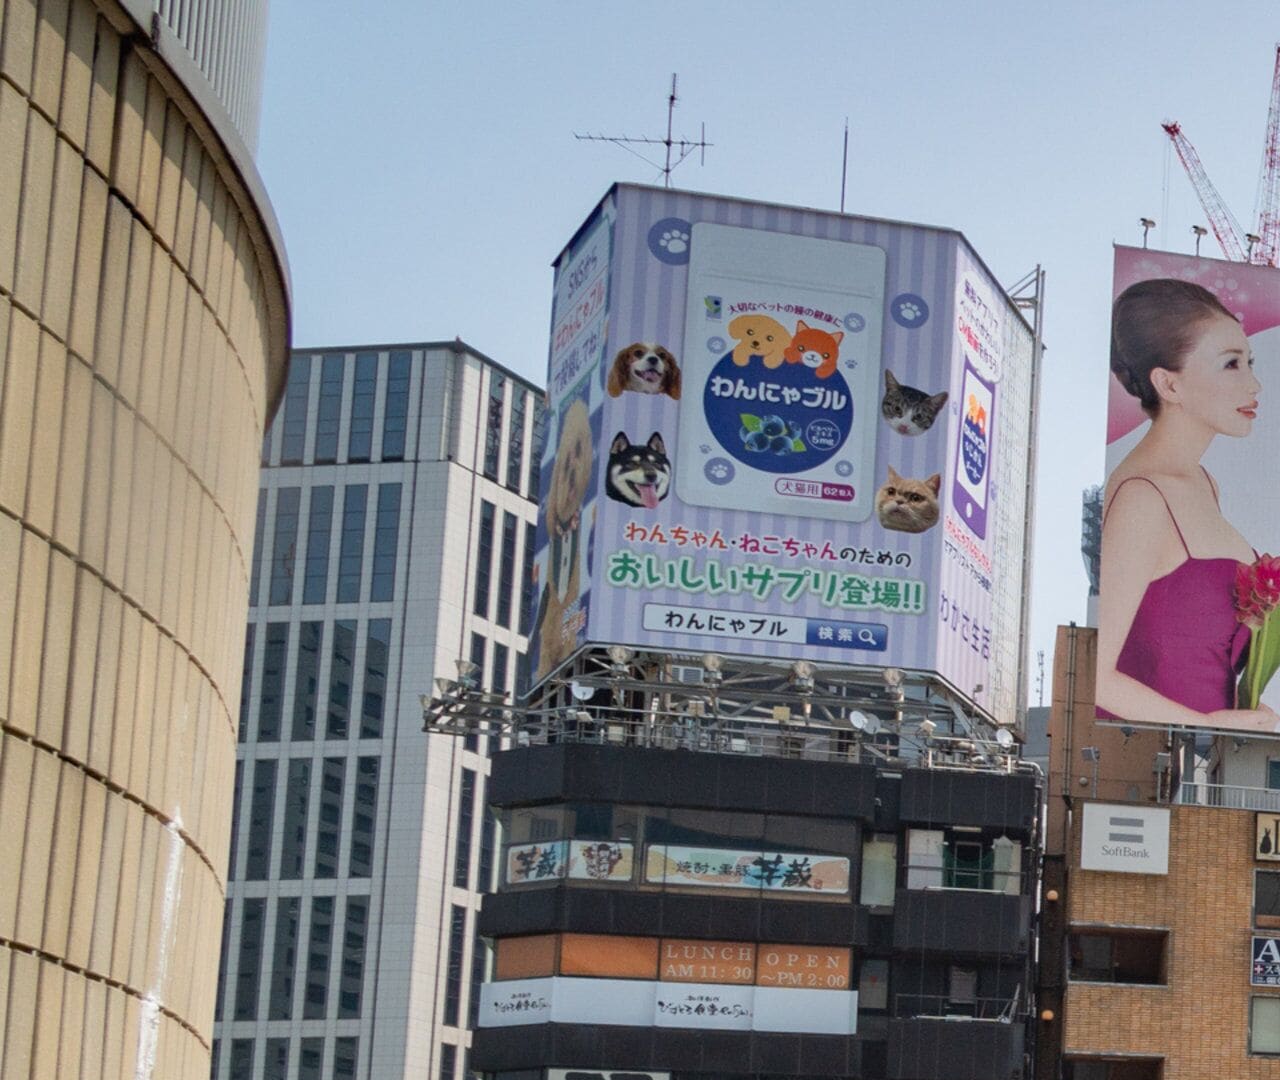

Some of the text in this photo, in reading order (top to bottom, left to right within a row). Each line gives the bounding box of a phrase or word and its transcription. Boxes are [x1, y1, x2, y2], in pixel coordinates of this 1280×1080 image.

[625, 521, 913, 569] わんちゃん・ねこちゃんのための
[664, 610, 788, 639] わんにゃブル
[817, 626, 854, 643] 検索
[1101, 844, 1150, 859] SoftBank
[666, 943, 842, 969] LUNCH OPEN
[665, 963, 696, 980] AM
[806, 973, 847, 988] 2:00
